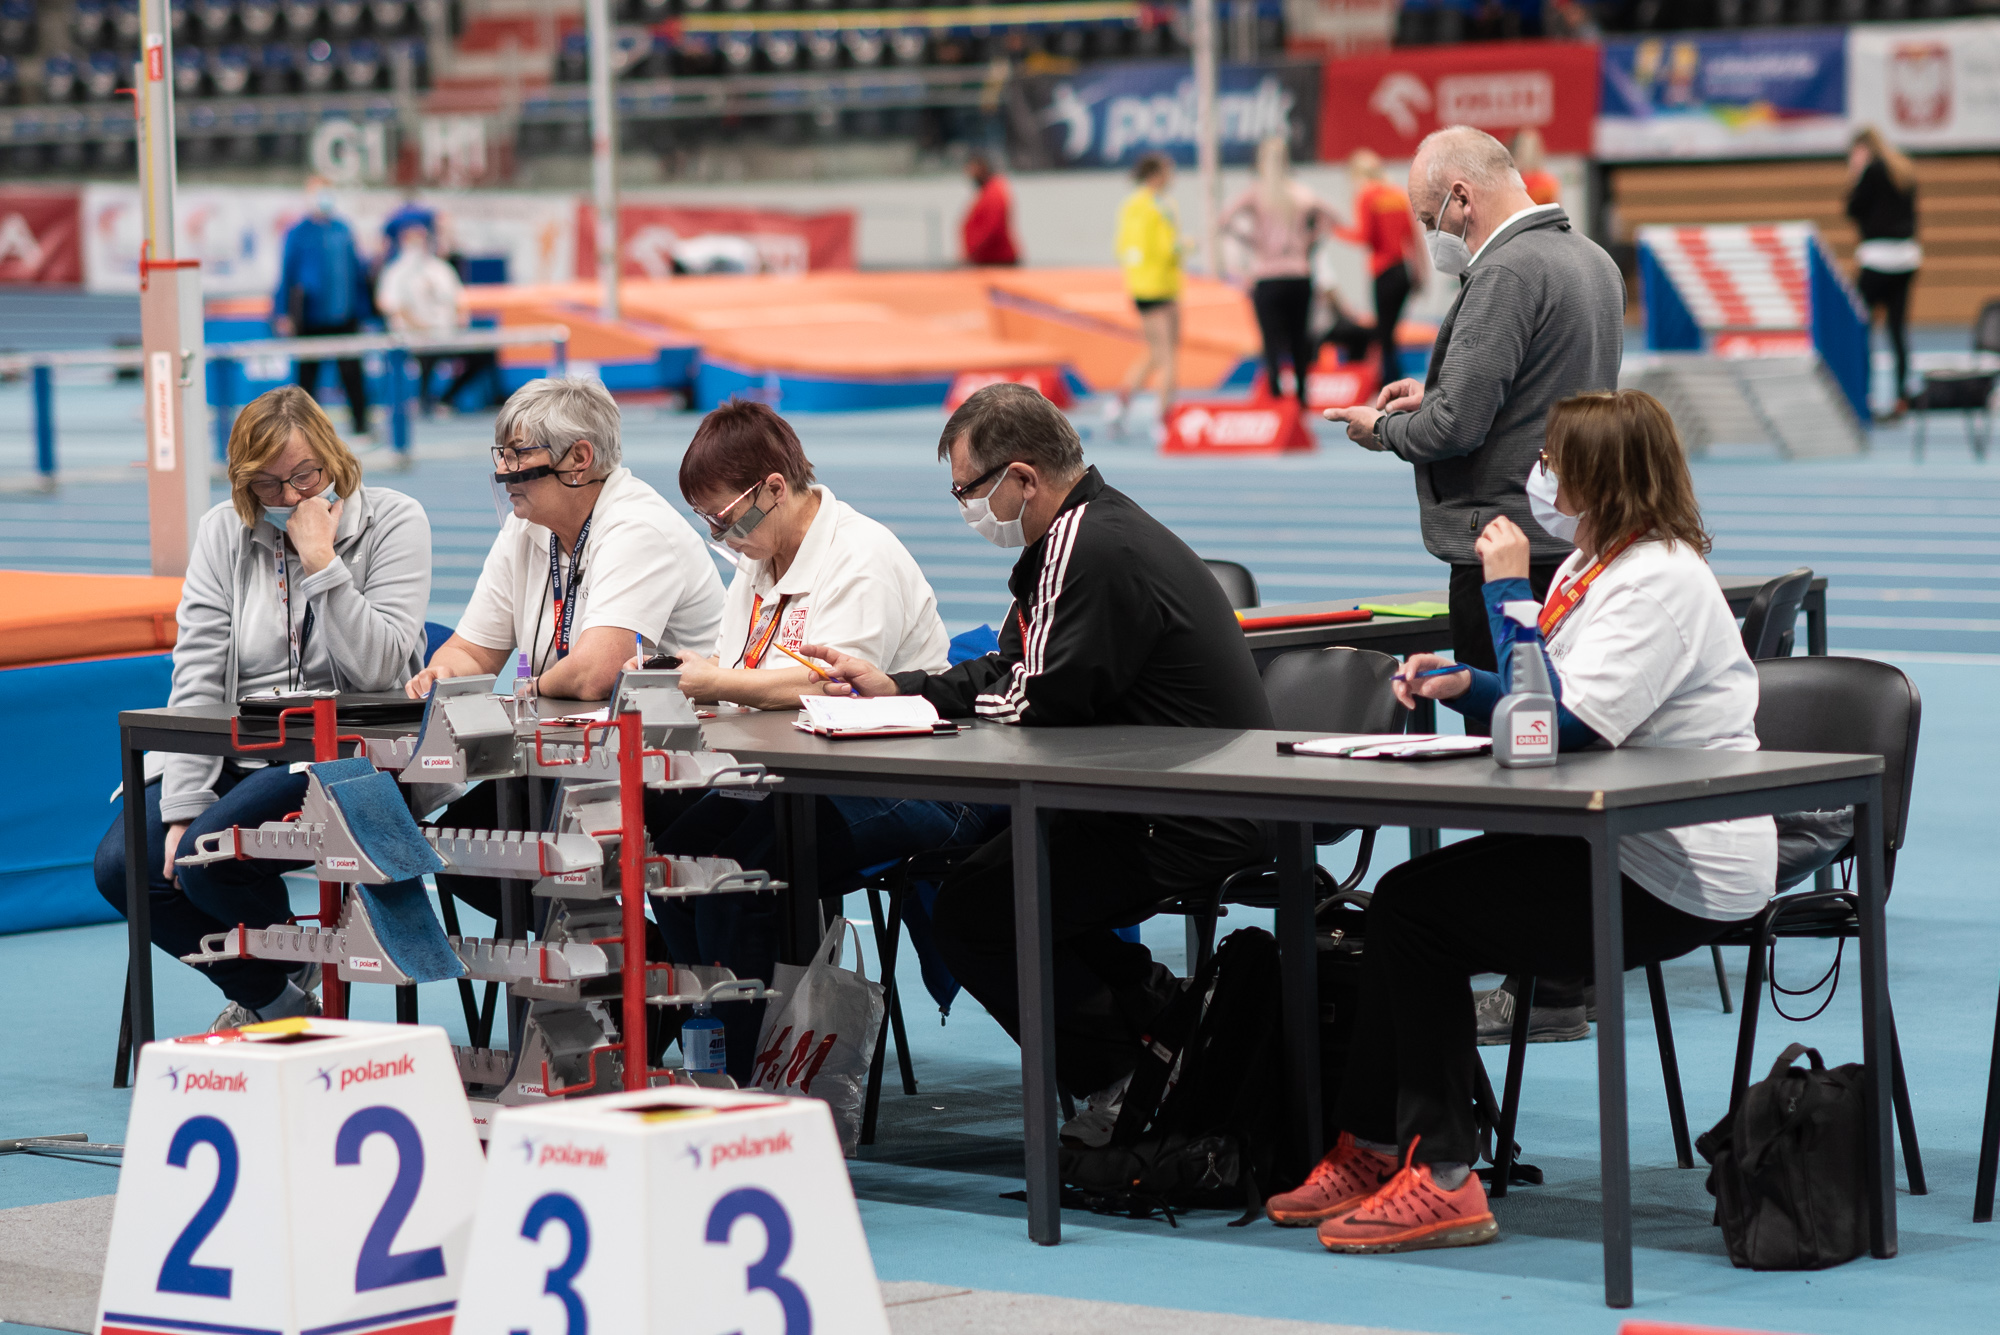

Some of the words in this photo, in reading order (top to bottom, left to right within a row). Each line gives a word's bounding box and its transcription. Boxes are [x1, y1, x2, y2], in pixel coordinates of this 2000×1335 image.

[1103, 77, 1300, 162] polnik
[564, 597, 575, 625] HALOWE
[562, 625, 571, 643] PZLA
[1517, 735, 1548, 745] ORLEN
[340, 1053, 416, 1092] polanik
[751, 1024, 838, 1094] H&M
[184, 1069, 248, 1094] polanik
[527, 1086, 545, 1094] polan
[538, 1141, 610, 1169] polanik
[711, 1129, 795, 1170] polanik
[156, 1115, 240, 1300] 2
[335, 1105, 447, 1294] 2
[509, 1191, 591, 1335] 3
[704, 1186, 814, 1335] 3
